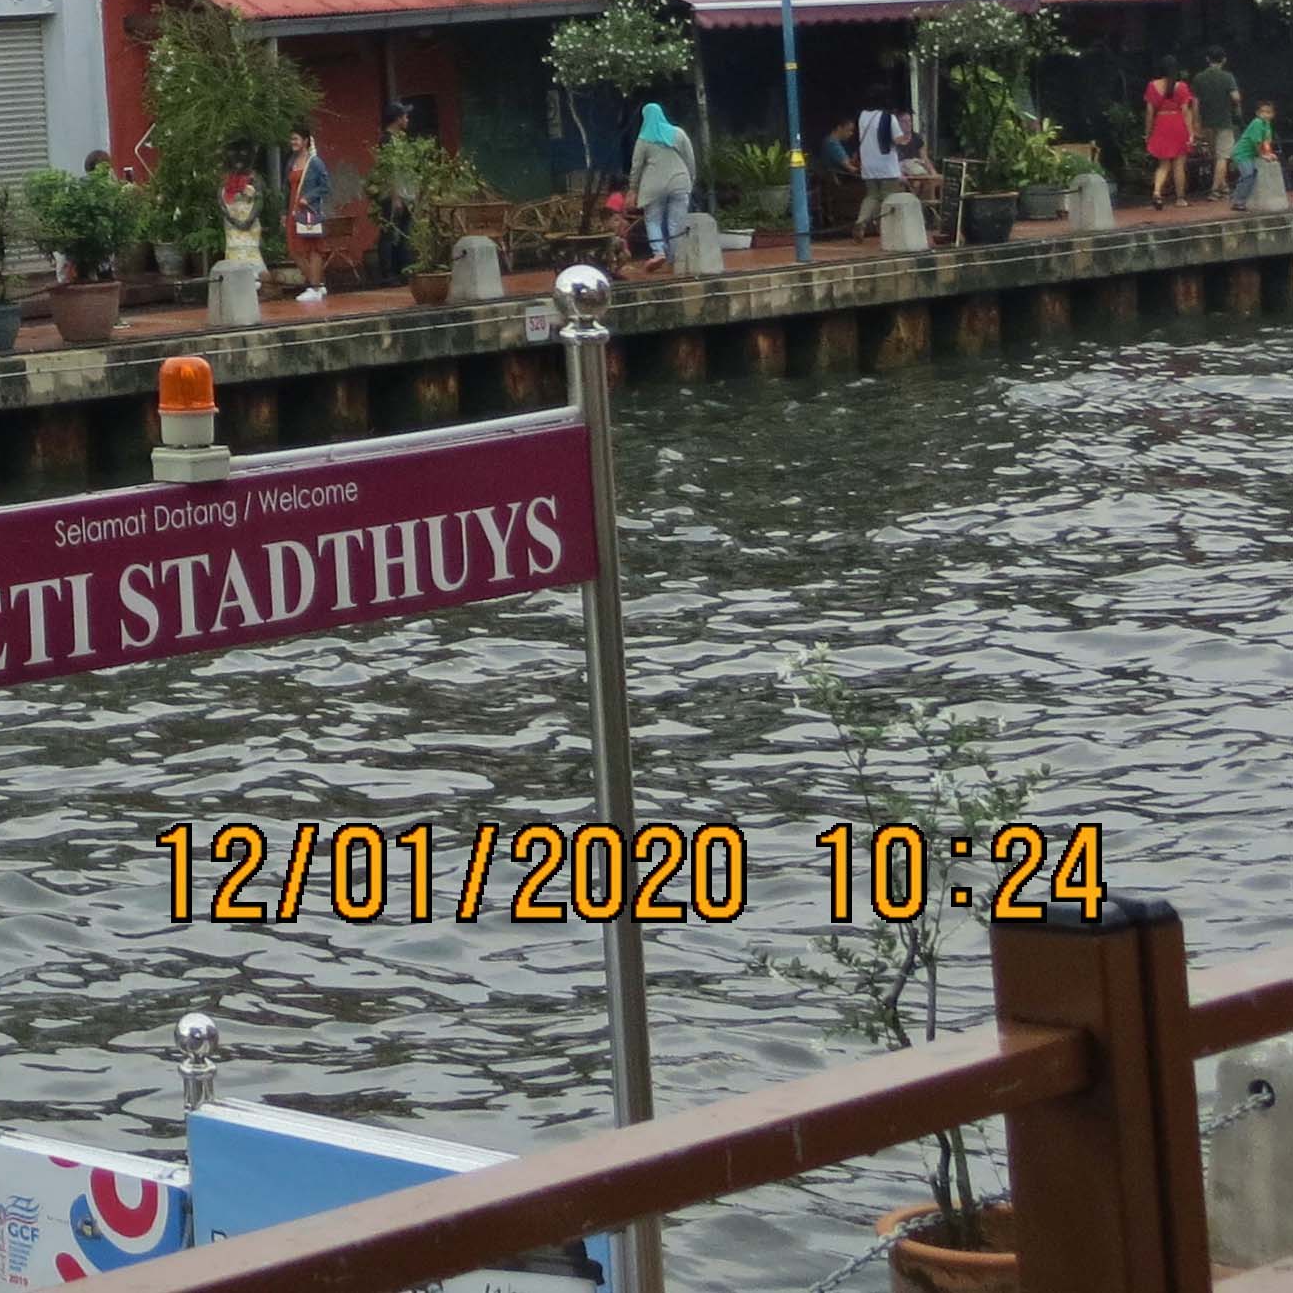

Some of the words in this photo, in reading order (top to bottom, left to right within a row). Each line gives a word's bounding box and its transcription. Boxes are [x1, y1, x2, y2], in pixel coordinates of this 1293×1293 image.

[54, 509, 148, 548] Selamat
[154, 500, 238, 532] Datang
[258, 481, 359, 513] Welcome
[118, 494, 563, 651] STADTHUYS
